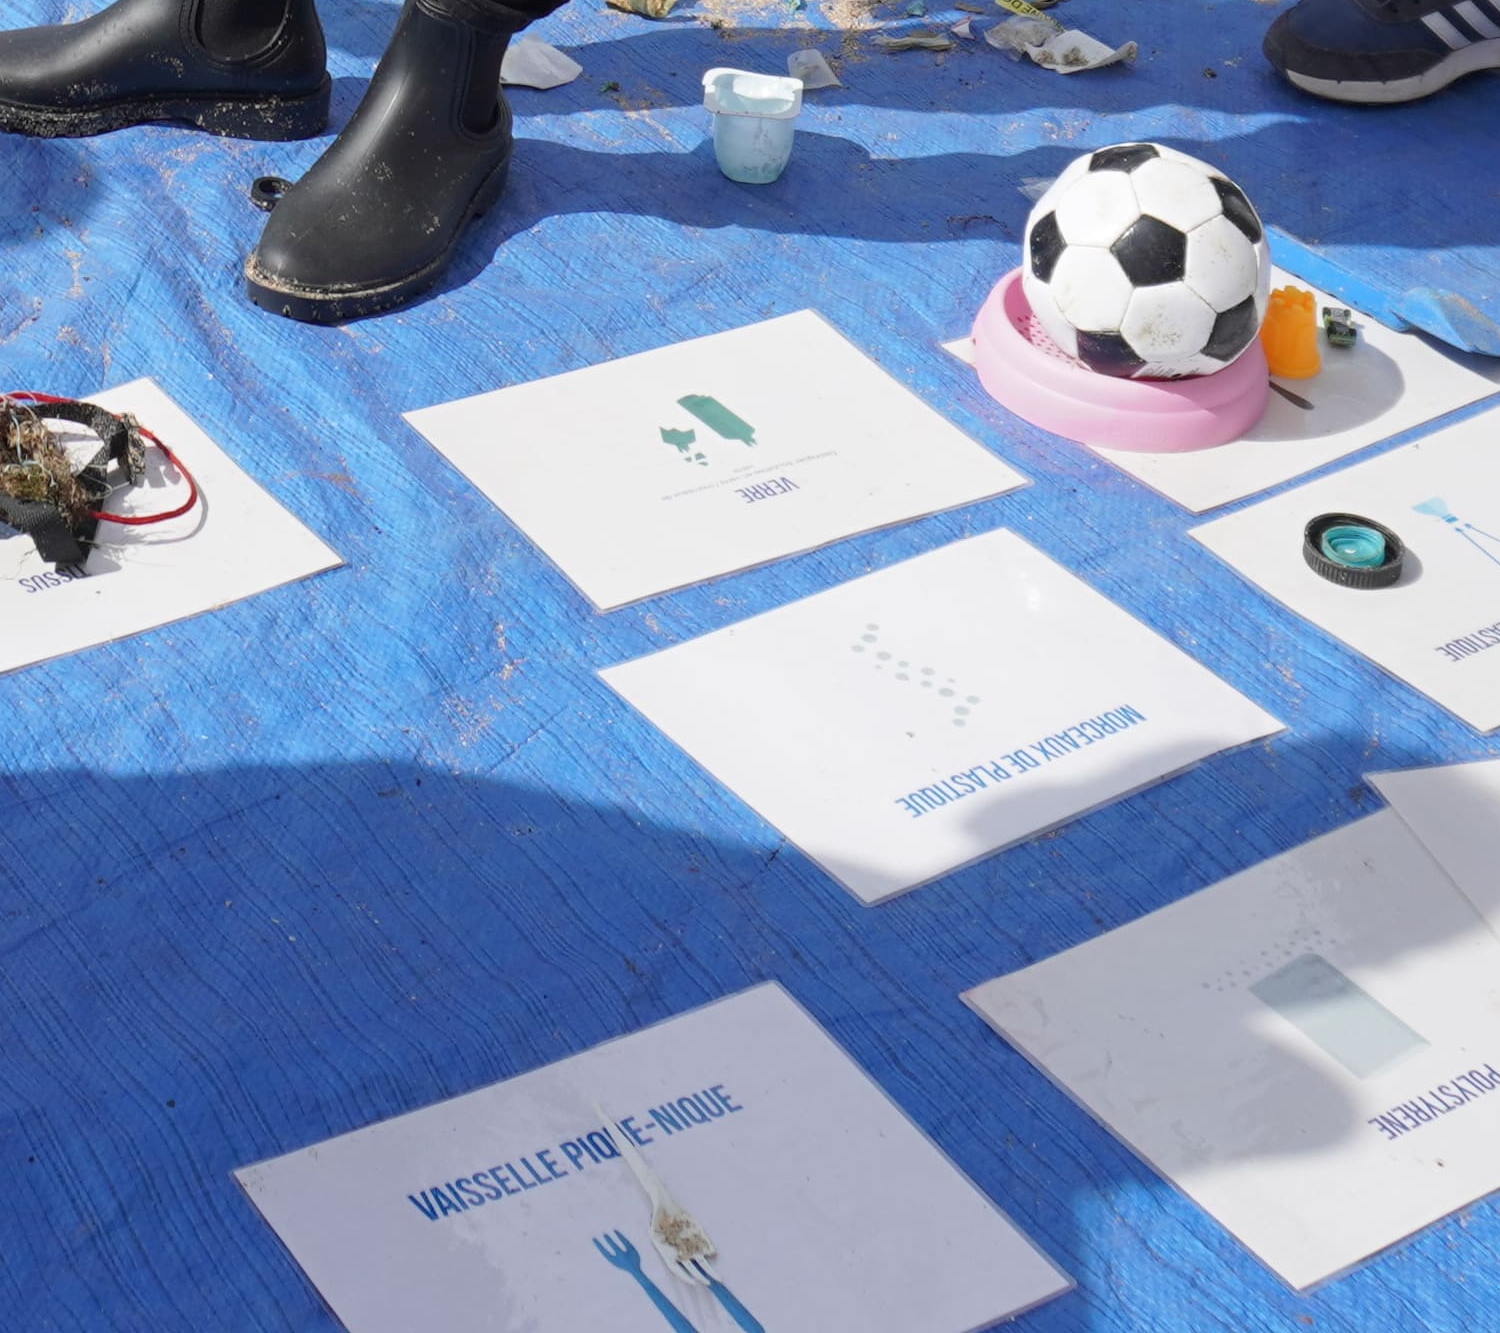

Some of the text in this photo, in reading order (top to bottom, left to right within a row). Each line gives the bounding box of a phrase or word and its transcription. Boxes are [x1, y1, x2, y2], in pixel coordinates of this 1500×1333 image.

[734, 477, 800, 504] VERRE
[894, 704, 1147, 818] MORCEAUX DE PLASTIQUE
[407, 1149, 568, 1221] VAISSELLE
